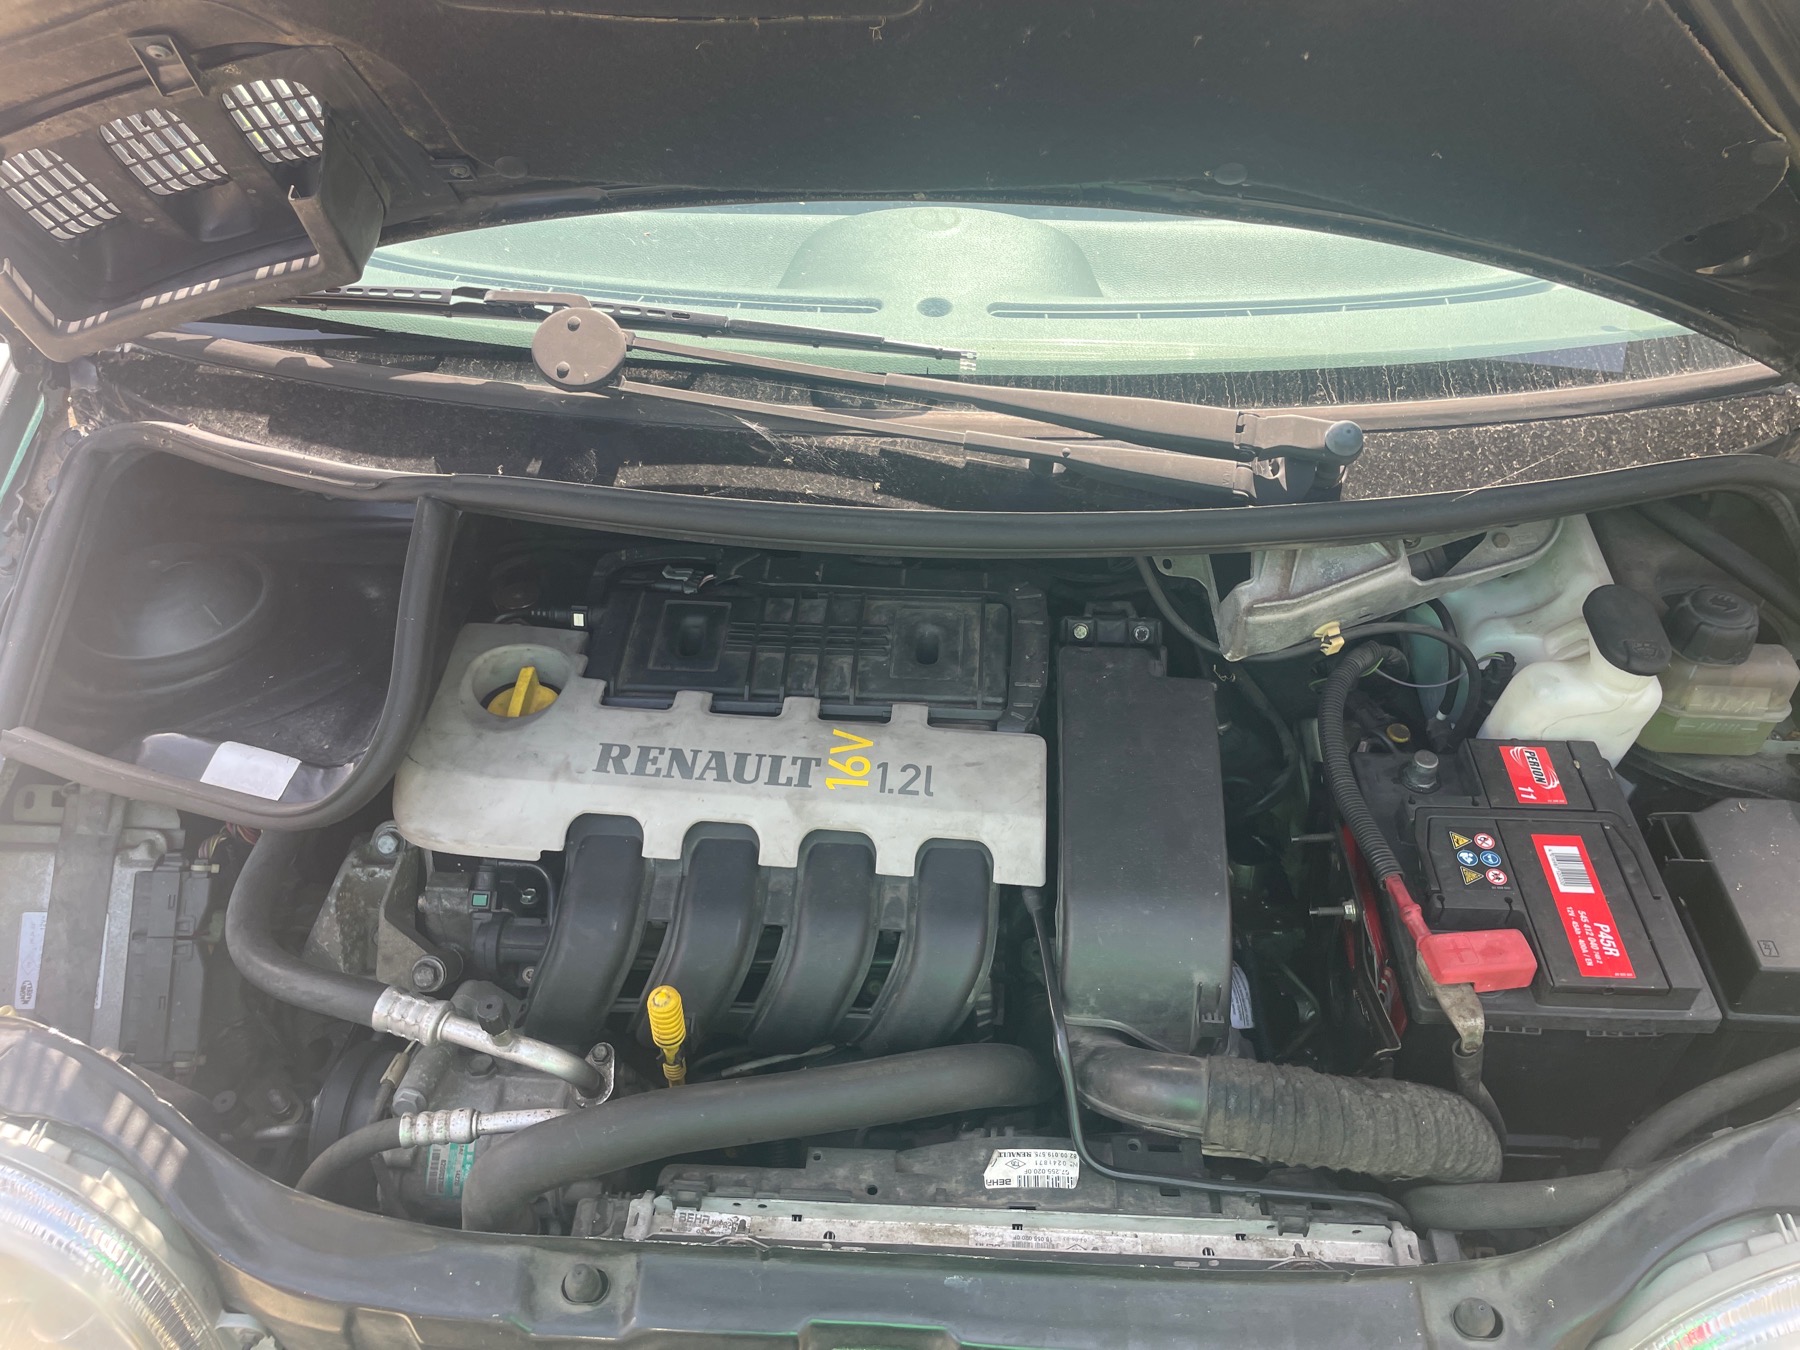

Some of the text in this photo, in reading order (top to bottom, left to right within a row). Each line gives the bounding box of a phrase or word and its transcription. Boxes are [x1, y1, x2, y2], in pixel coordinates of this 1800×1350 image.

[592, 742, 822, 788] RENAULT
[825, 729, 874, 790] 16V
[1525, 750, 1547, 784] PERION
[1518, 786, 1537, 800] 11
[1578, 910, 1590, 923] 545
[1566, 906, 1576, 917] 12V
[1571, 921, 1582, 935] 45Ah
[1578, 938, 1589, 953] 400A
[1584, 958, 1594, 967] EN
[1583, 923, 1594, 937] 412
[1587, 936, 1600, 951] 040
[1593, 922, 1620, 957] P45R
[985, 1178, 1012, 1186] BEHR
[679, 1212, 711, 1224] BEHR
